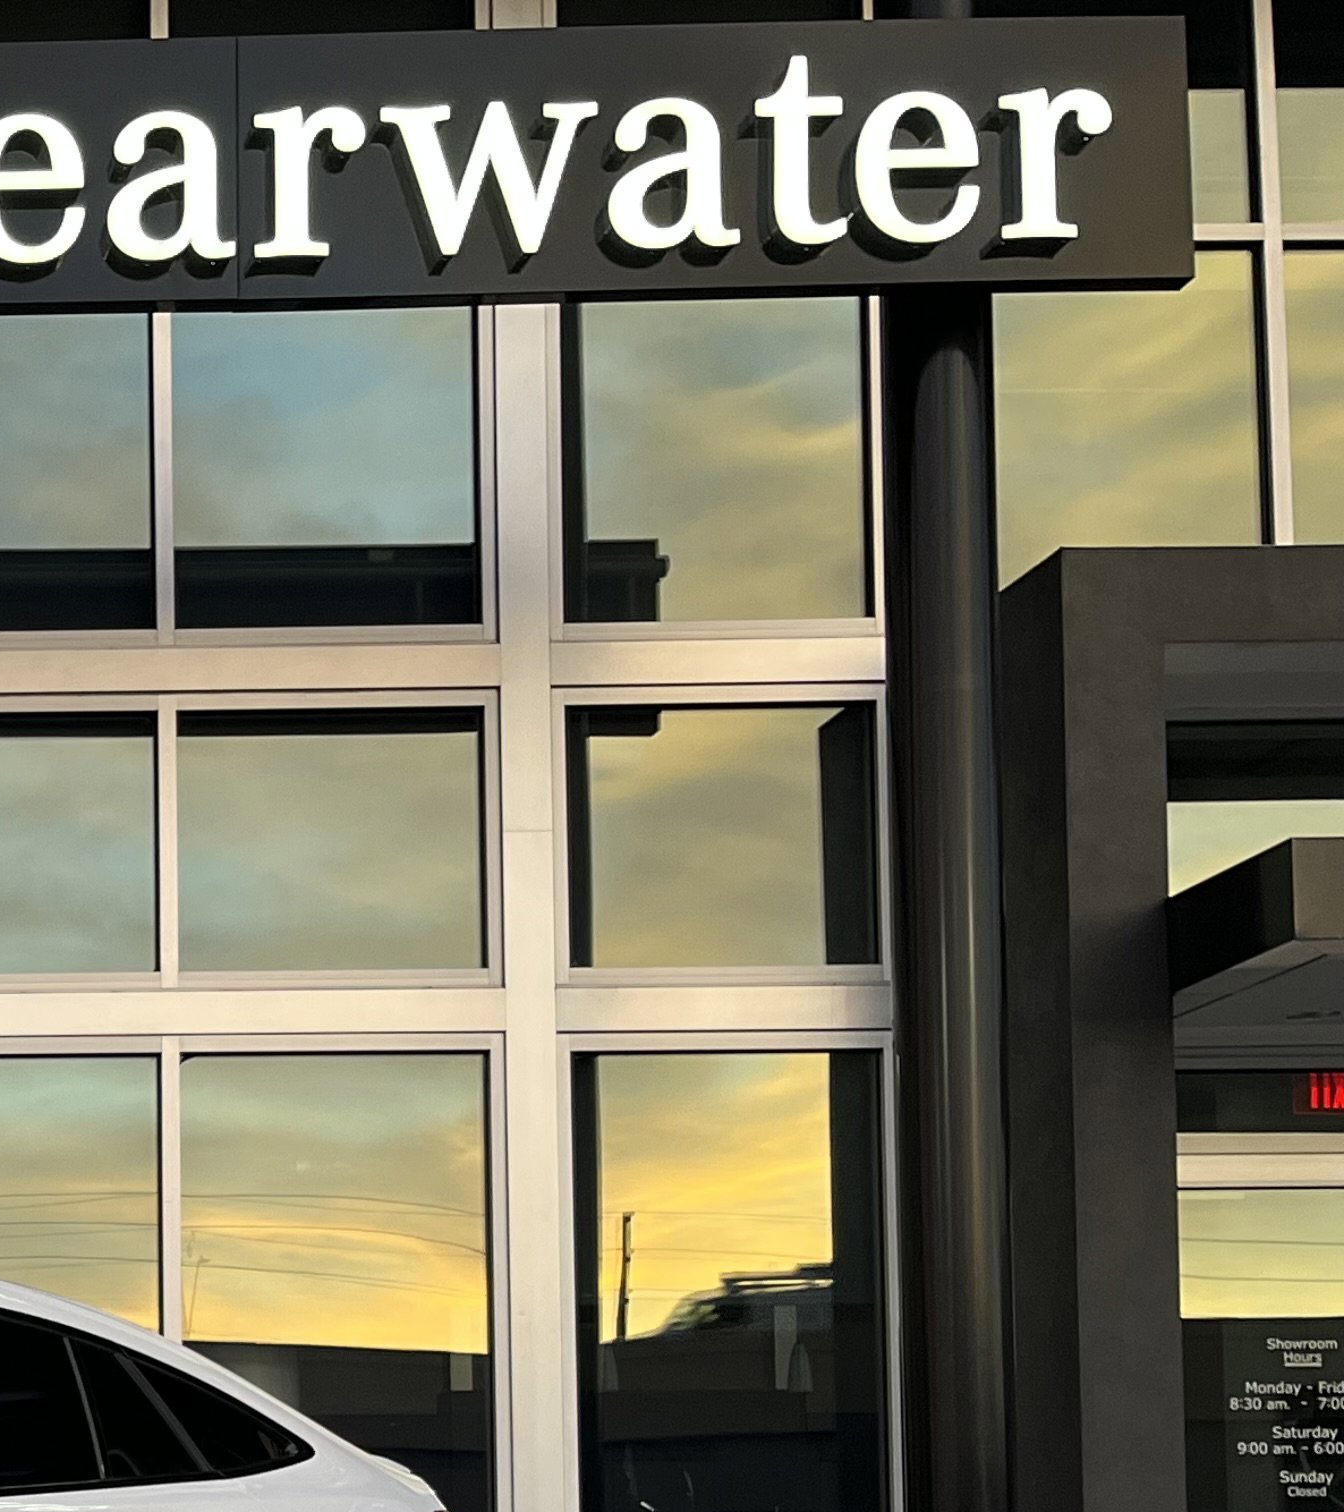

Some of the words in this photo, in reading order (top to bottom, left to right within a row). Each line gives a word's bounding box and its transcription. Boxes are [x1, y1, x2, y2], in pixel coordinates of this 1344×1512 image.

[1266, 1338, 1338, 1350] Showroom
[1283, 1352, 1323, 1365] Hours
[1245, 1381, 1302, 1396] Monday
[1229, 1398, 1263, 1411] 8:30
[1266, 1400, 1291, 1411] am.
[1272, 1426, 1338, 1440] Saturday
[1237, 1442, 1269, 1455] 9:00
[1273, 1444, 1297, 1455] am.
[1279, 1470, 1334, 1486] Sunday
[1287, 1486, 1328, 1498] Closed
